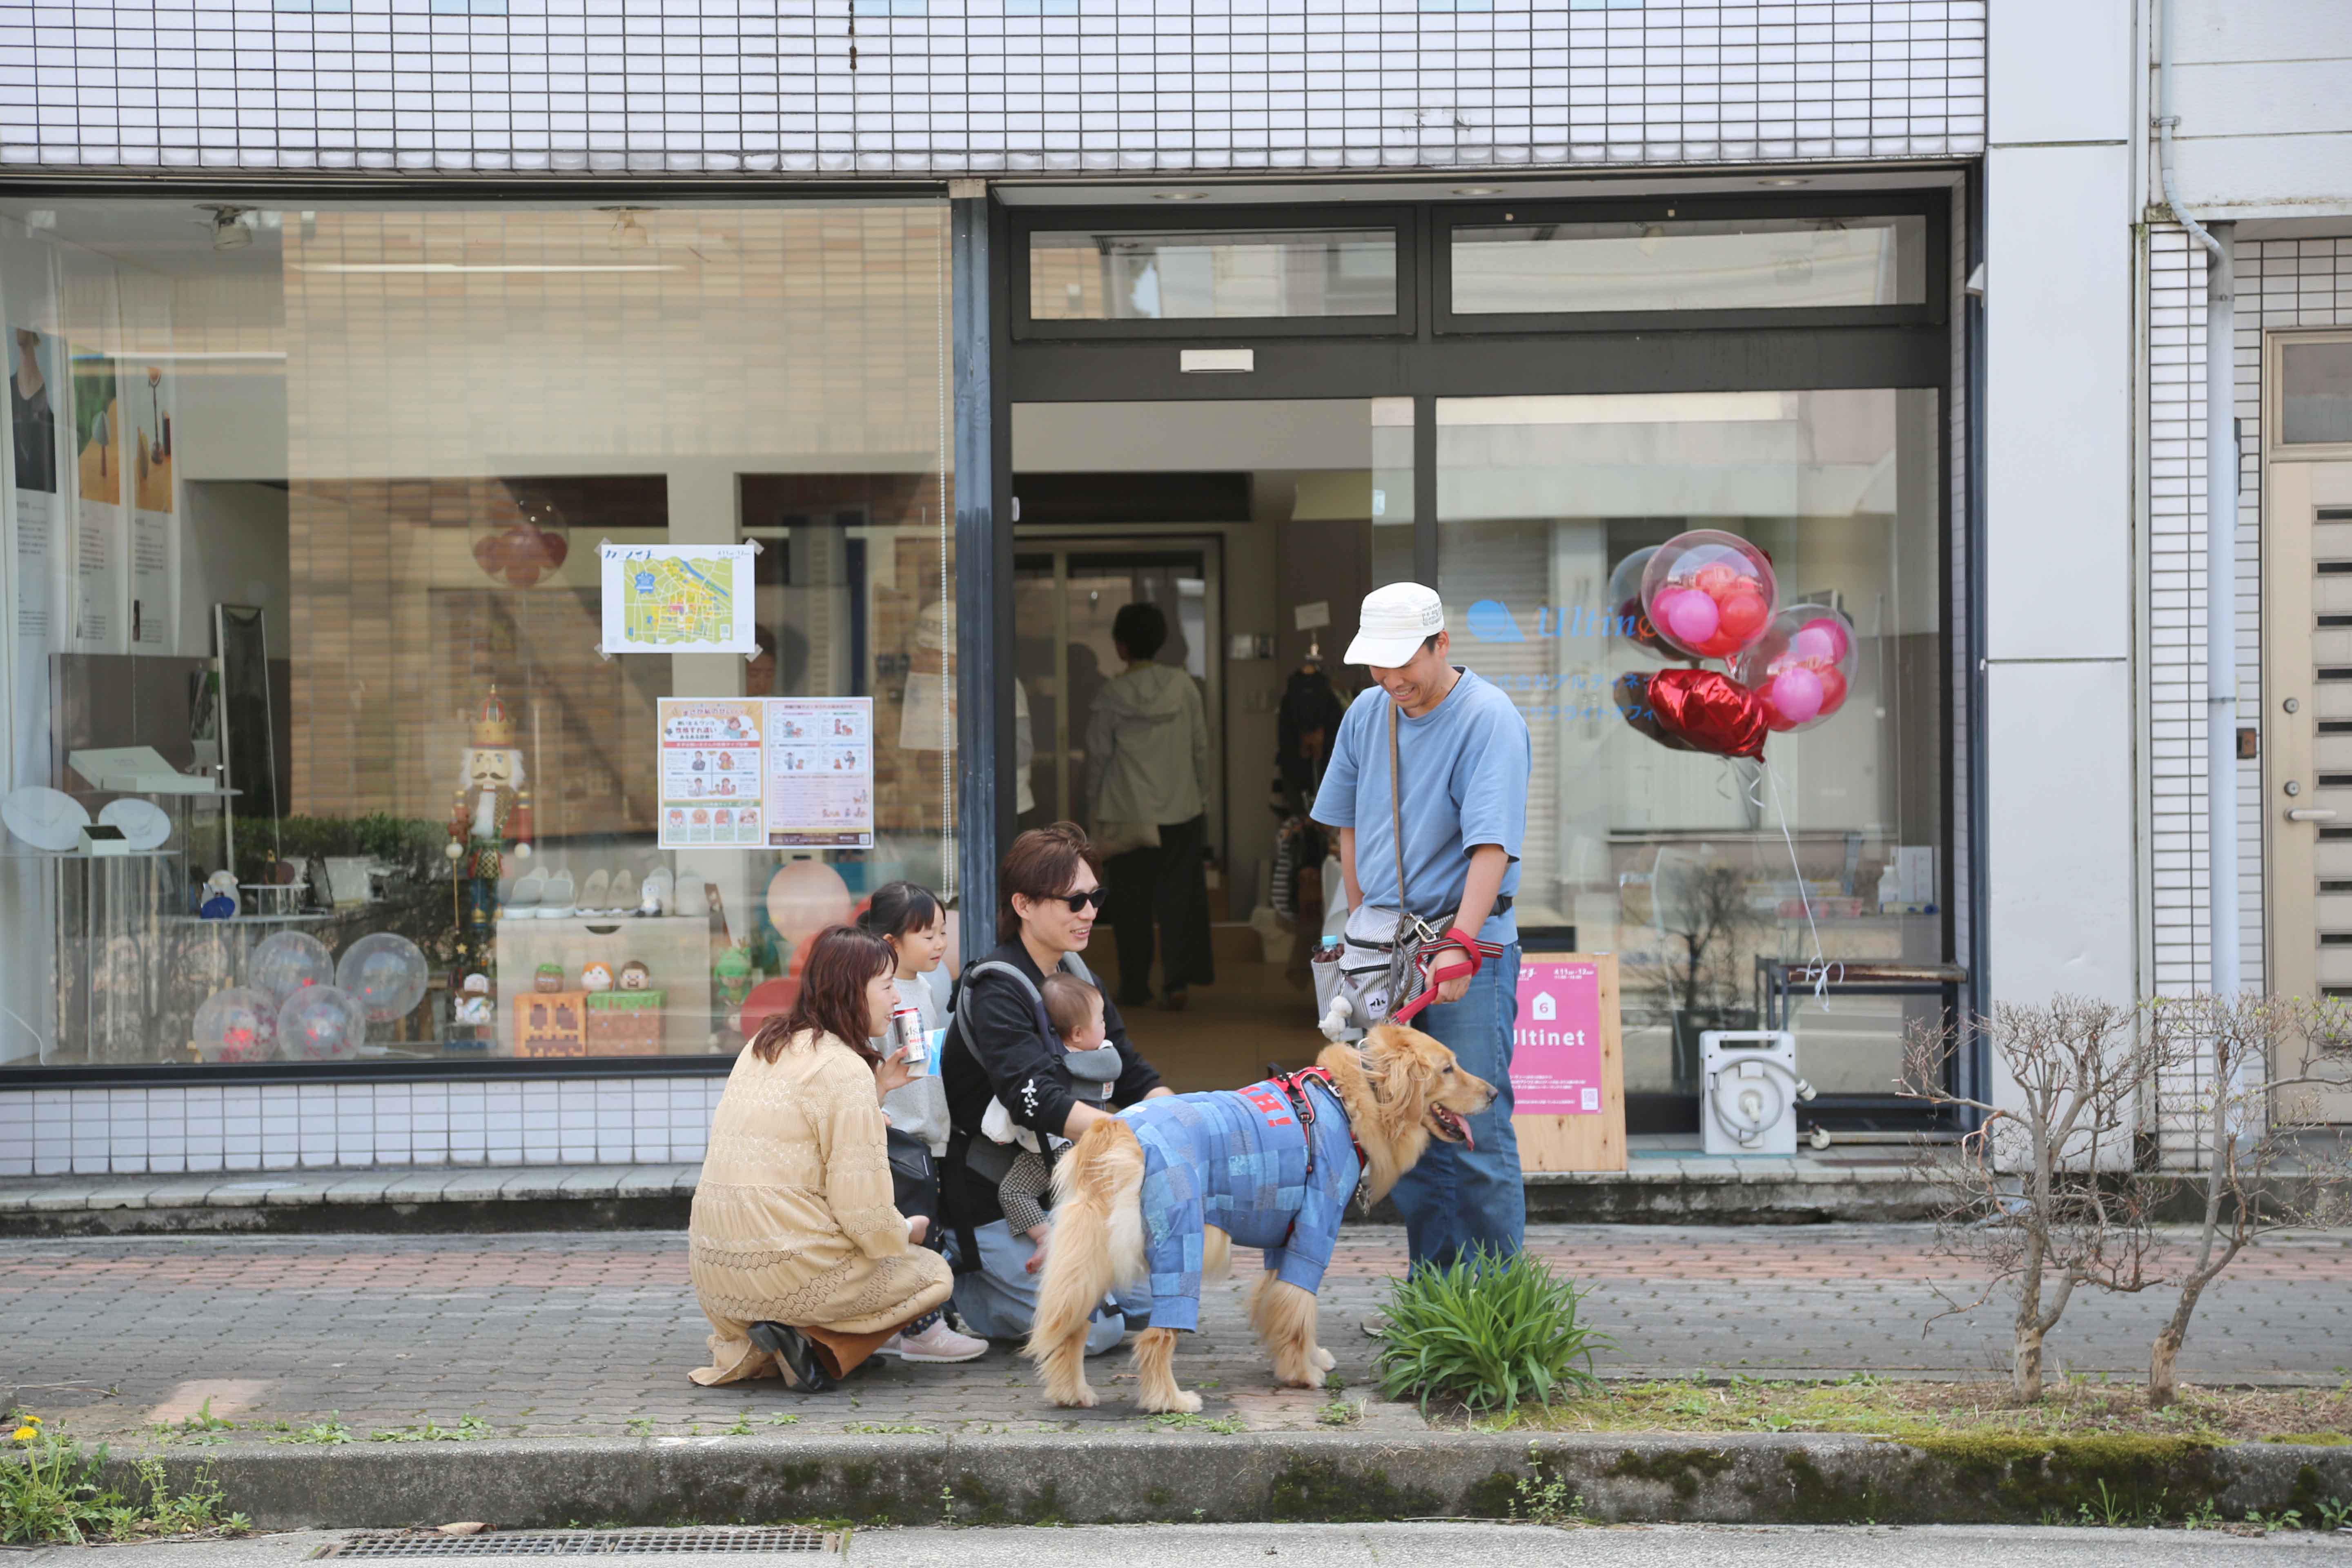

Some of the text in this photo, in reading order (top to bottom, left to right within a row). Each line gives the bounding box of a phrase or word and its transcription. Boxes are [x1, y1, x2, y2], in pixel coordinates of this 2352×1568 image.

[1481, 674, 1649, 690] 式会社アルティネ
[1539, 1002, 1548, 1013] 6
